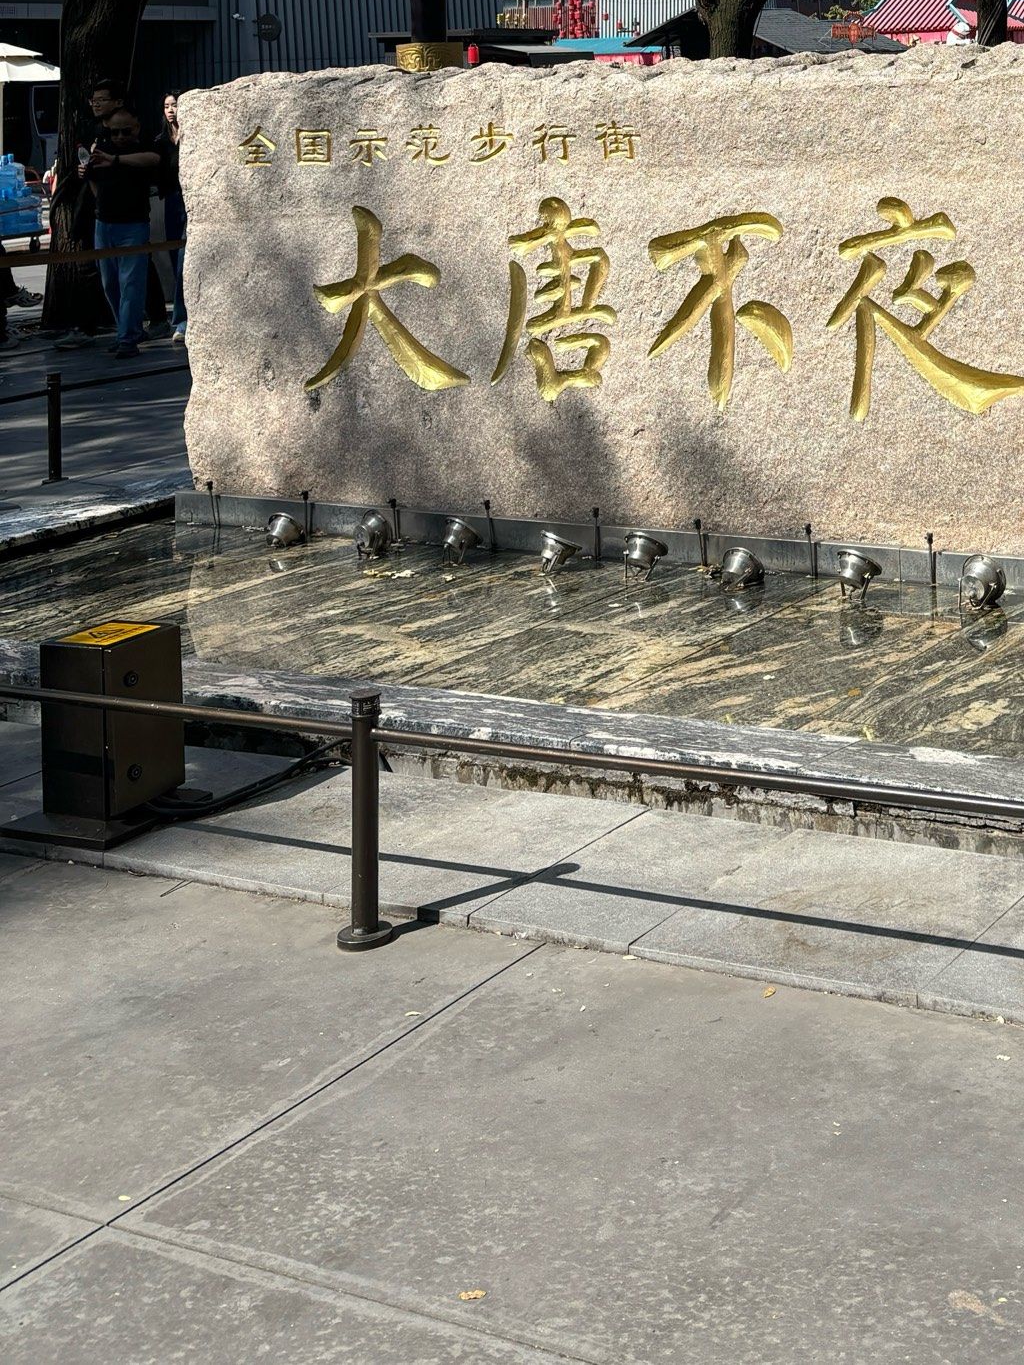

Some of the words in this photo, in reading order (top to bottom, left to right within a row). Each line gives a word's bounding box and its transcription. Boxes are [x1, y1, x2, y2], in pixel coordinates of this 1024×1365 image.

[237, 121, 641, 167] 全国示范步行街
